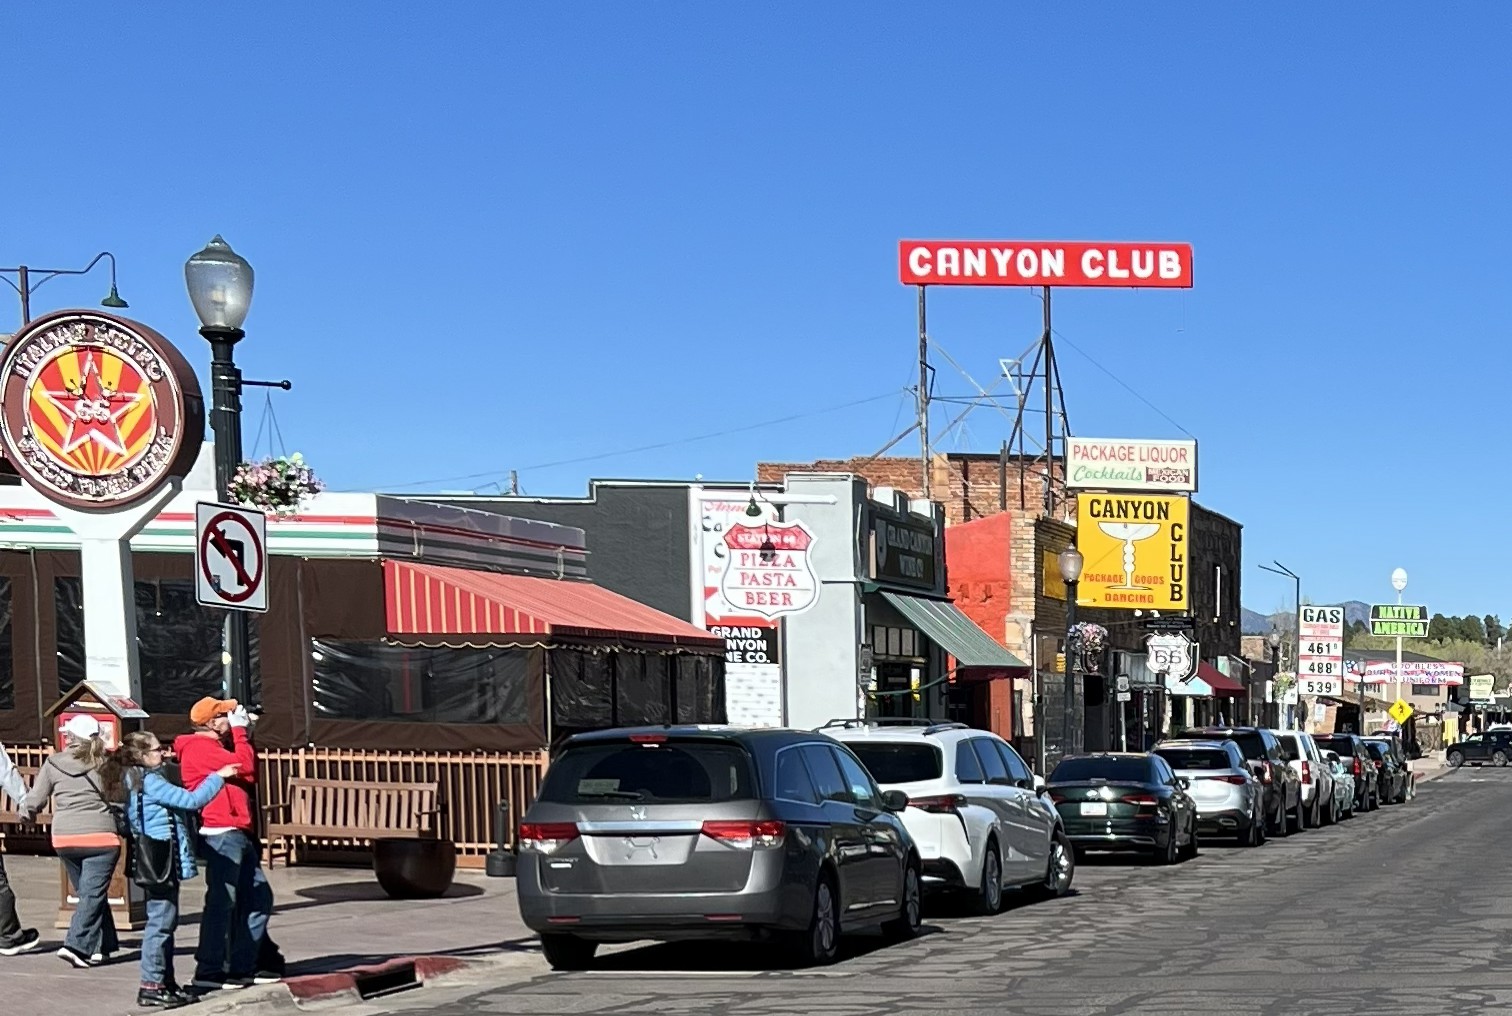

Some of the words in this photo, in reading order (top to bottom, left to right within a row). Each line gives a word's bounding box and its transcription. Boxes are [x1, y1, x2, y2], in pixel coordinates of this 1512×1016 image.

[908, 246, 1065, 278] CANYON
[1081, 248, 1182, 280] CLUB
[1073, 444, 1135, 462] PACKAGE
[1139, 446, 1188, 464] LIQUOR
[1073, 465, 1143, 482] Cocktails
[1147, 468, 1189, 477] MEXICAN
[1152, 475, 1186, 483] FOOD
[1090, 498, 1170, 520] CANYON
[1170, 522, 1184, 602] CLUB
[740, 571, 797, 587] PASTA
[745, 591, 794, 606] BEER
[1104, 593, 1154, 604] DANCING
[1303, 608, 1341, 624] GAS
[1378, 605, 1420, 620] NATIVE
[710, 626, 762, 639] GRAND
[1374, 621, 1425, 635] AMERICA
[726, 638, 767, 651] NYON
[745, 651, 771, 663] CO.
[1155, 649, 1182, 664] 66
